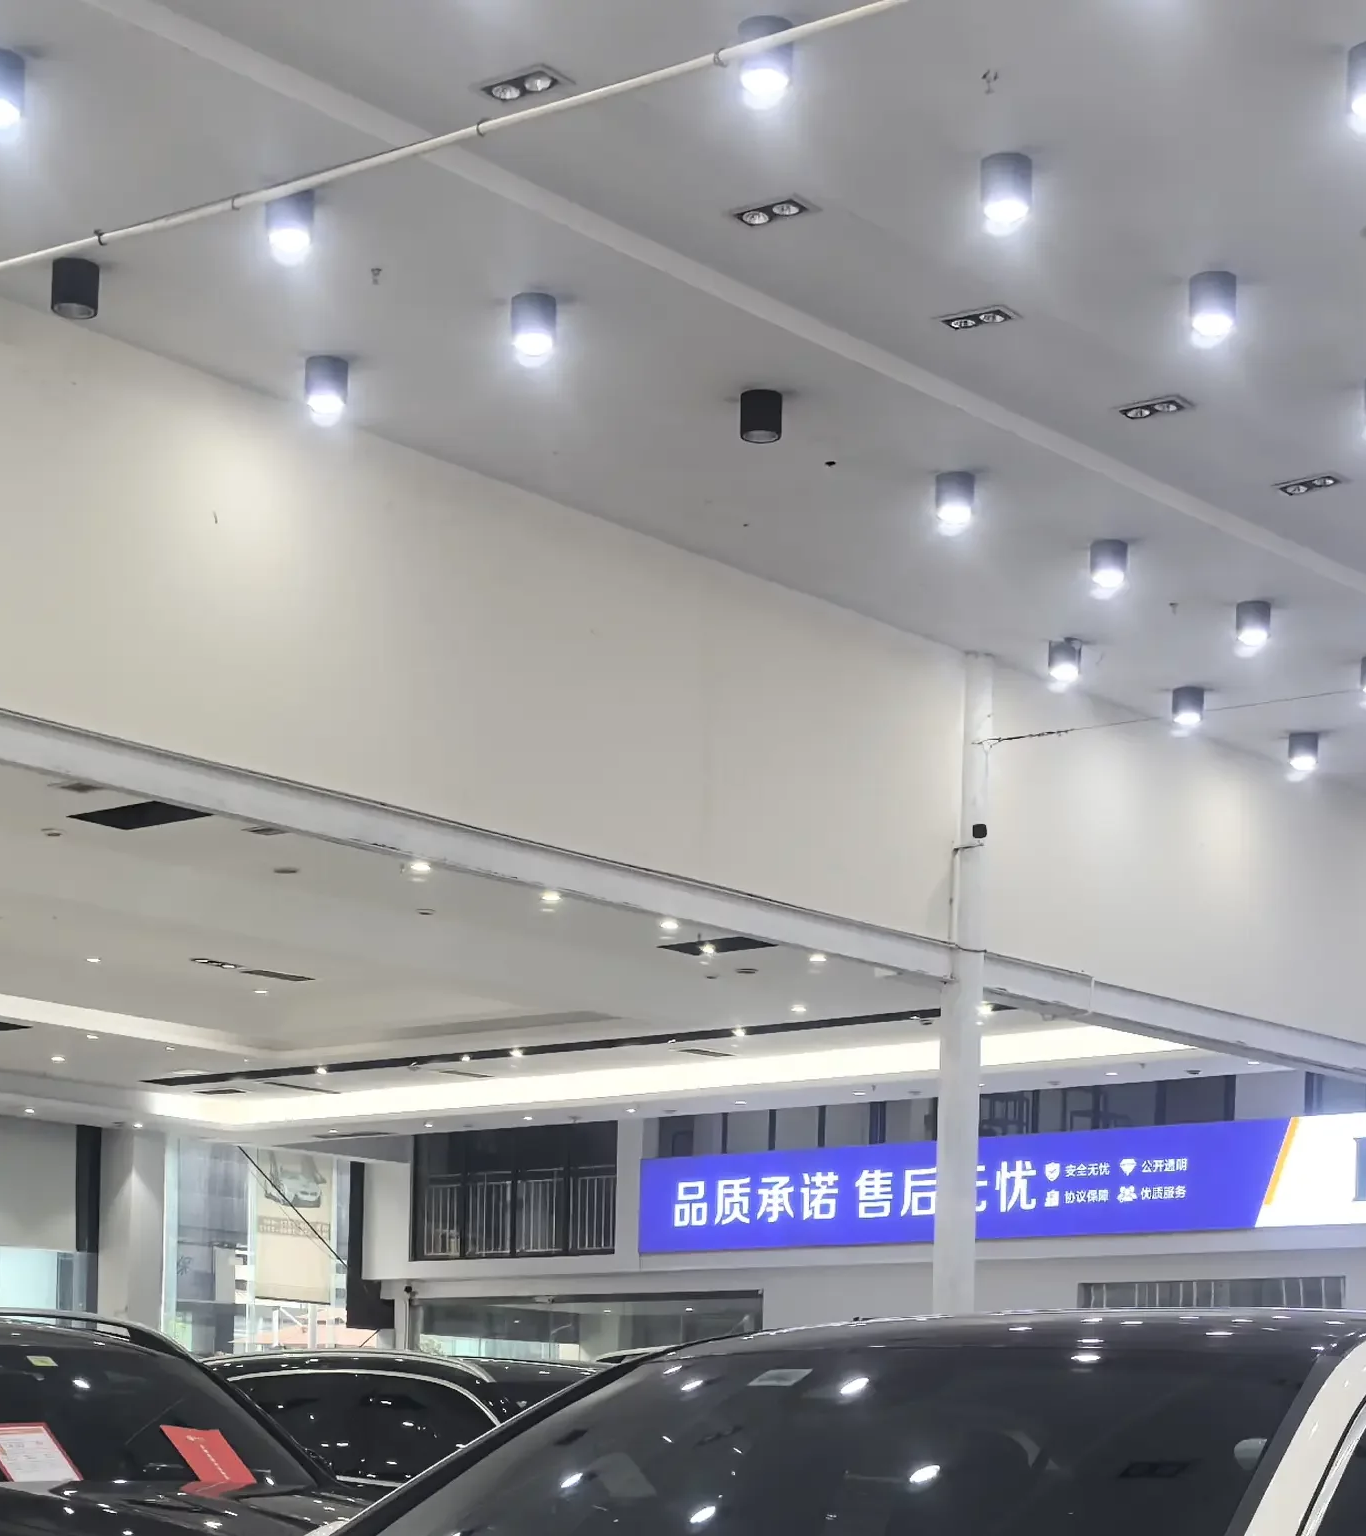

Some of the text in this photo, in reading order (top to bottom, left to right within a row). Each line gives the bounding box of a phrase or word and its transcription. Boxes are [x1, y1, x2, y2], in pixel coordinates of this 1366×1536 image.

[1065, 1162, 1111, 1178] 安全无忧
[1141, 1157, 1188, 1173] 公开透明
[673, 1171, 839, 1228] 品质承诺
[1064, 1189, 1110, 1204] 协议保障
[1140, 1185, 1187, 1200] 优质服务
